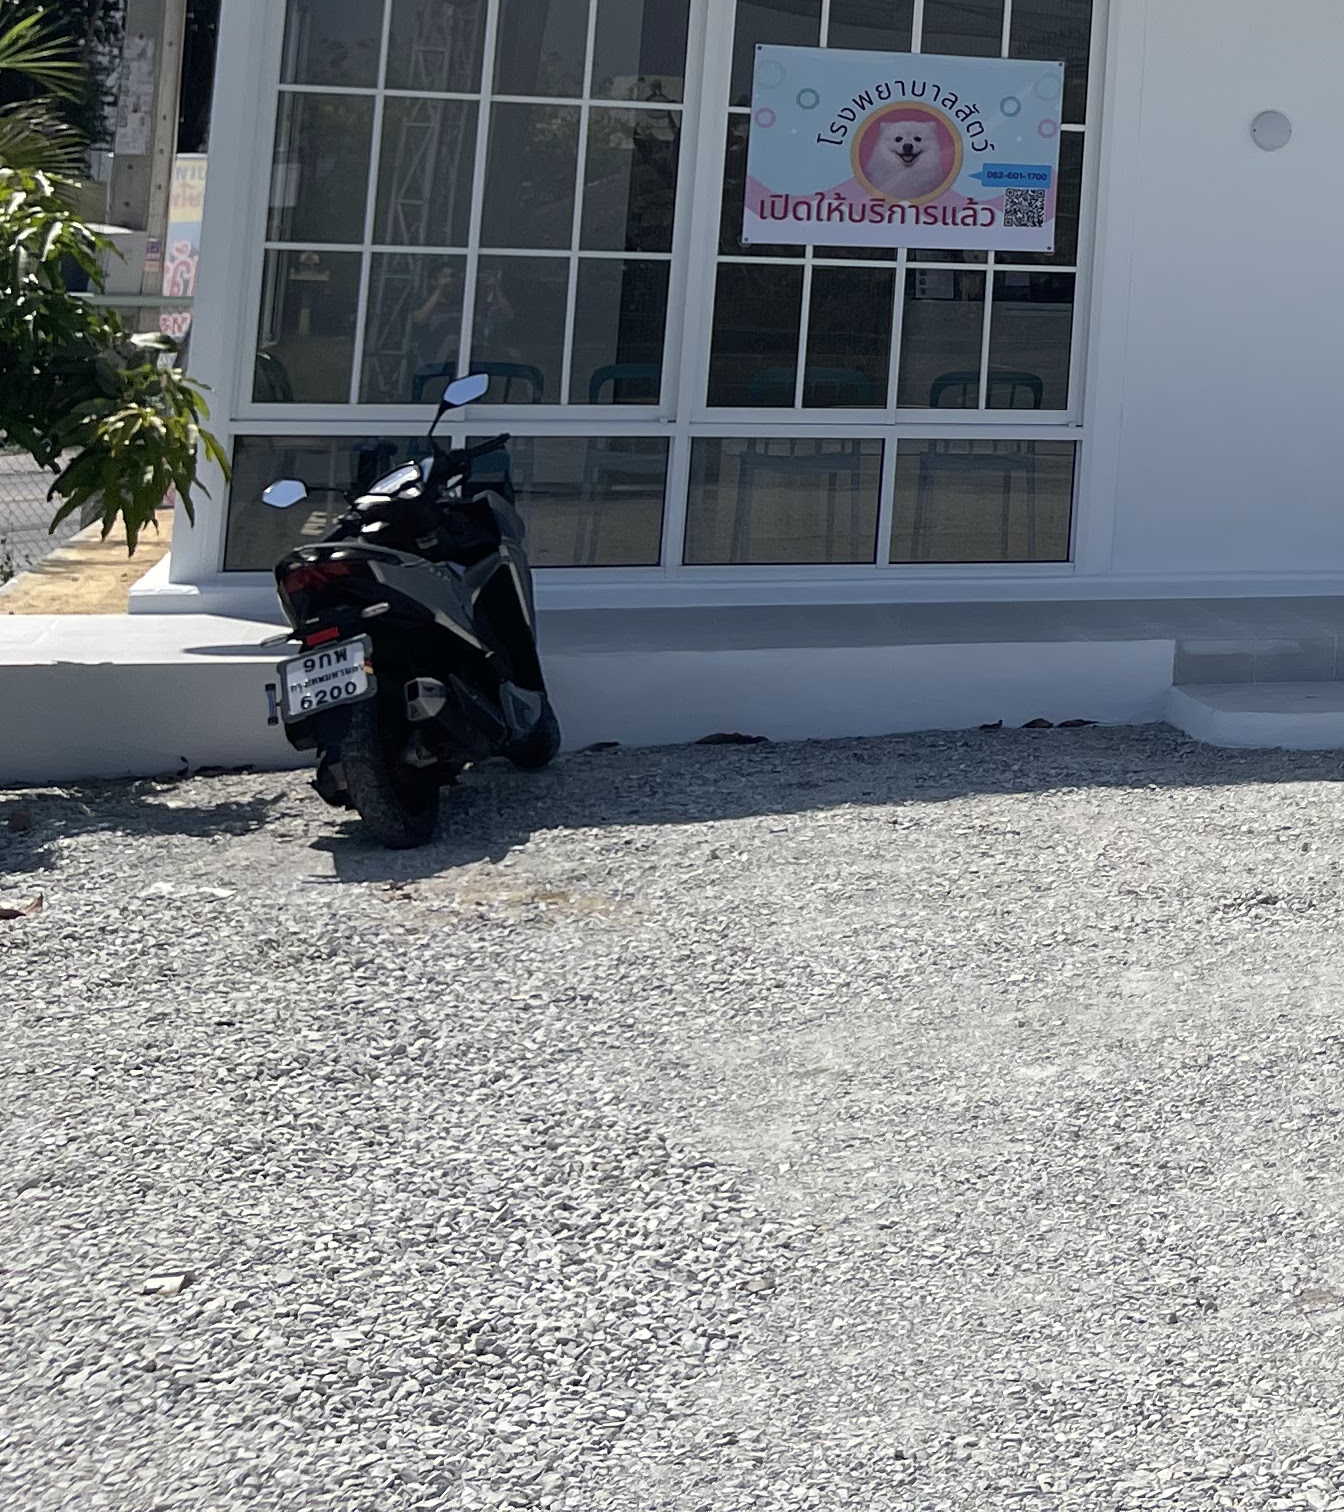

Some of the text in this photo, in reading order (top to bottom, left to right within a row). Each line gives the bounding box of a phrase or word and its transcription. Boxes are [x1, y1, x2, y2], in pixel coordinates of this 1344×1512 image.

[816, 79, 996, 153] โรงพยาบาลสัตว์
[758, 191, 996, 228] เปิดให้บริการแล้ว
[303, 647, 348, 673] 9กพ
[300, 681, 357, 710] 6200
